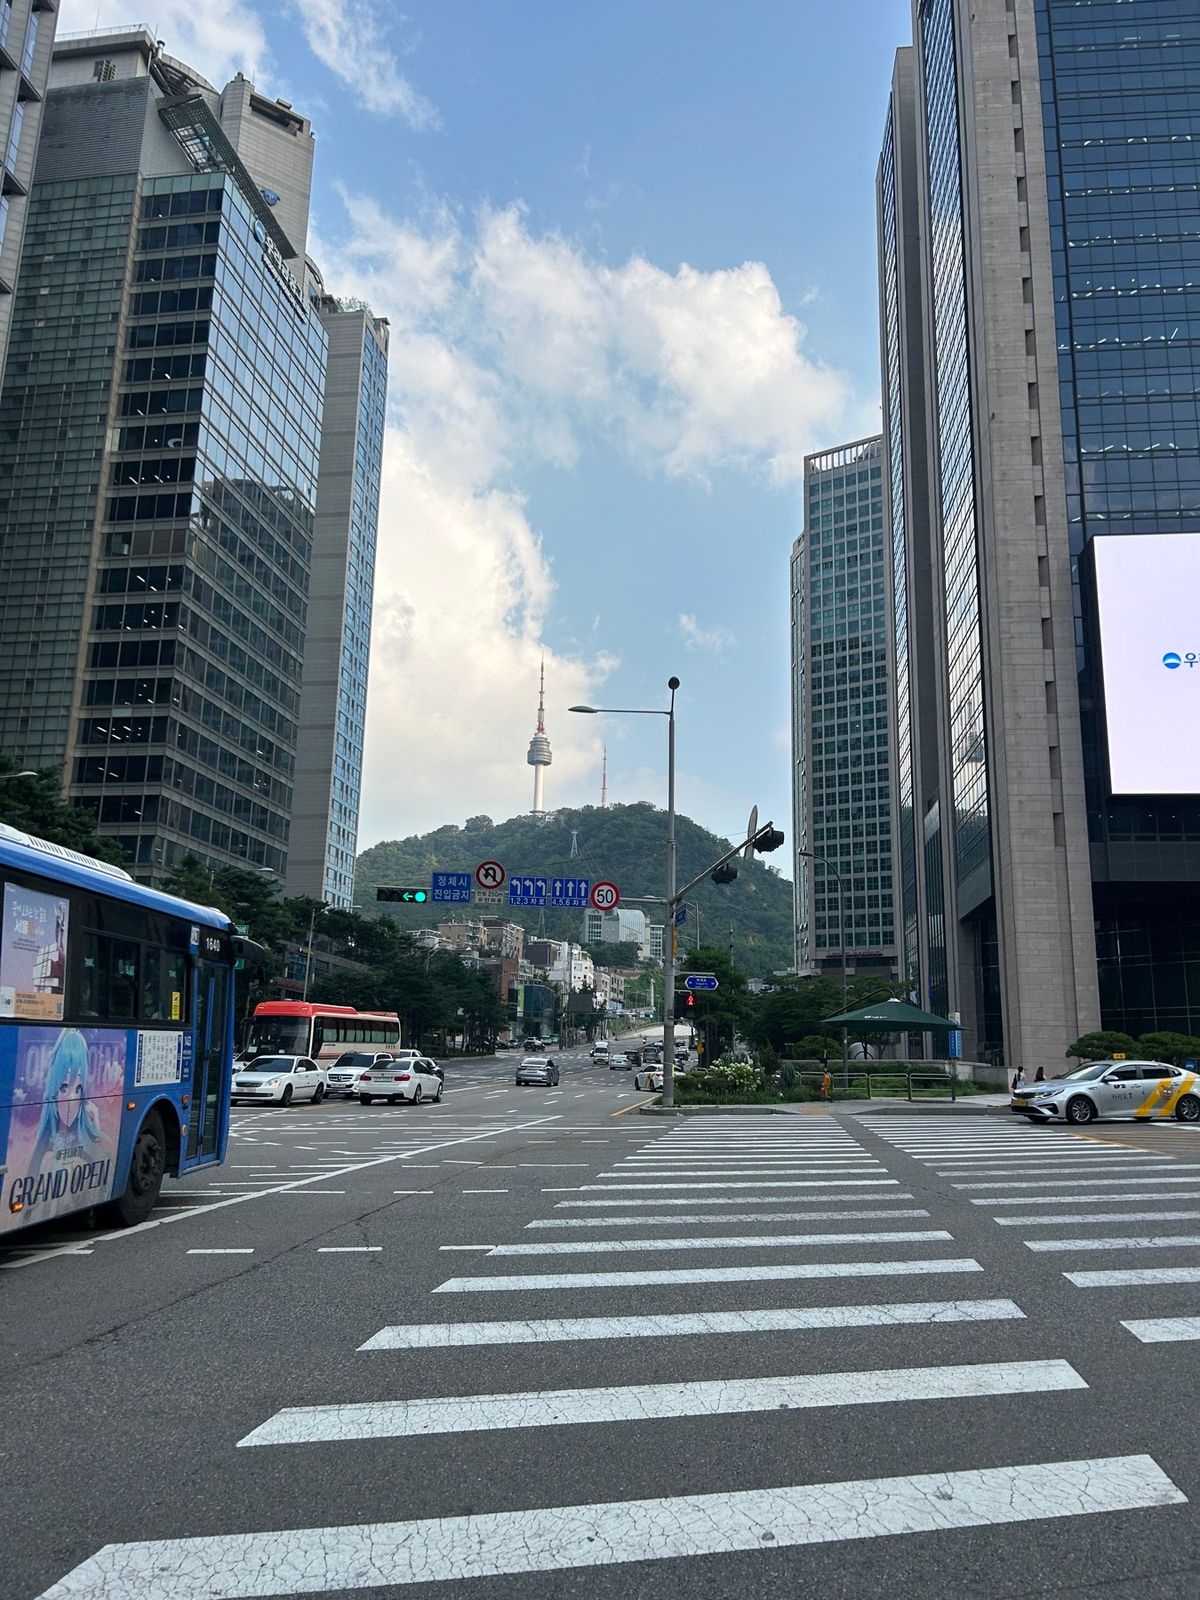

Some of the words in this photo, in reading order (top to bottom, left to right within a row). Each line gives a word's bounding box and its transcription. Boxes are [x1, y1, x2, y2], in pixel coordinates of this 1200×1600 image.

[1184, 652, 1200, 668] 우
[438, 875, 467, 887] 정체시
[434, 889, 469, 900] 진입금지
[597, 889, 614, 904] 50
[206, 937, 221, 952] 1640
[9, 1168, 69, 1211] GRAND
[71, 1158, 111, 1195] OPEN
